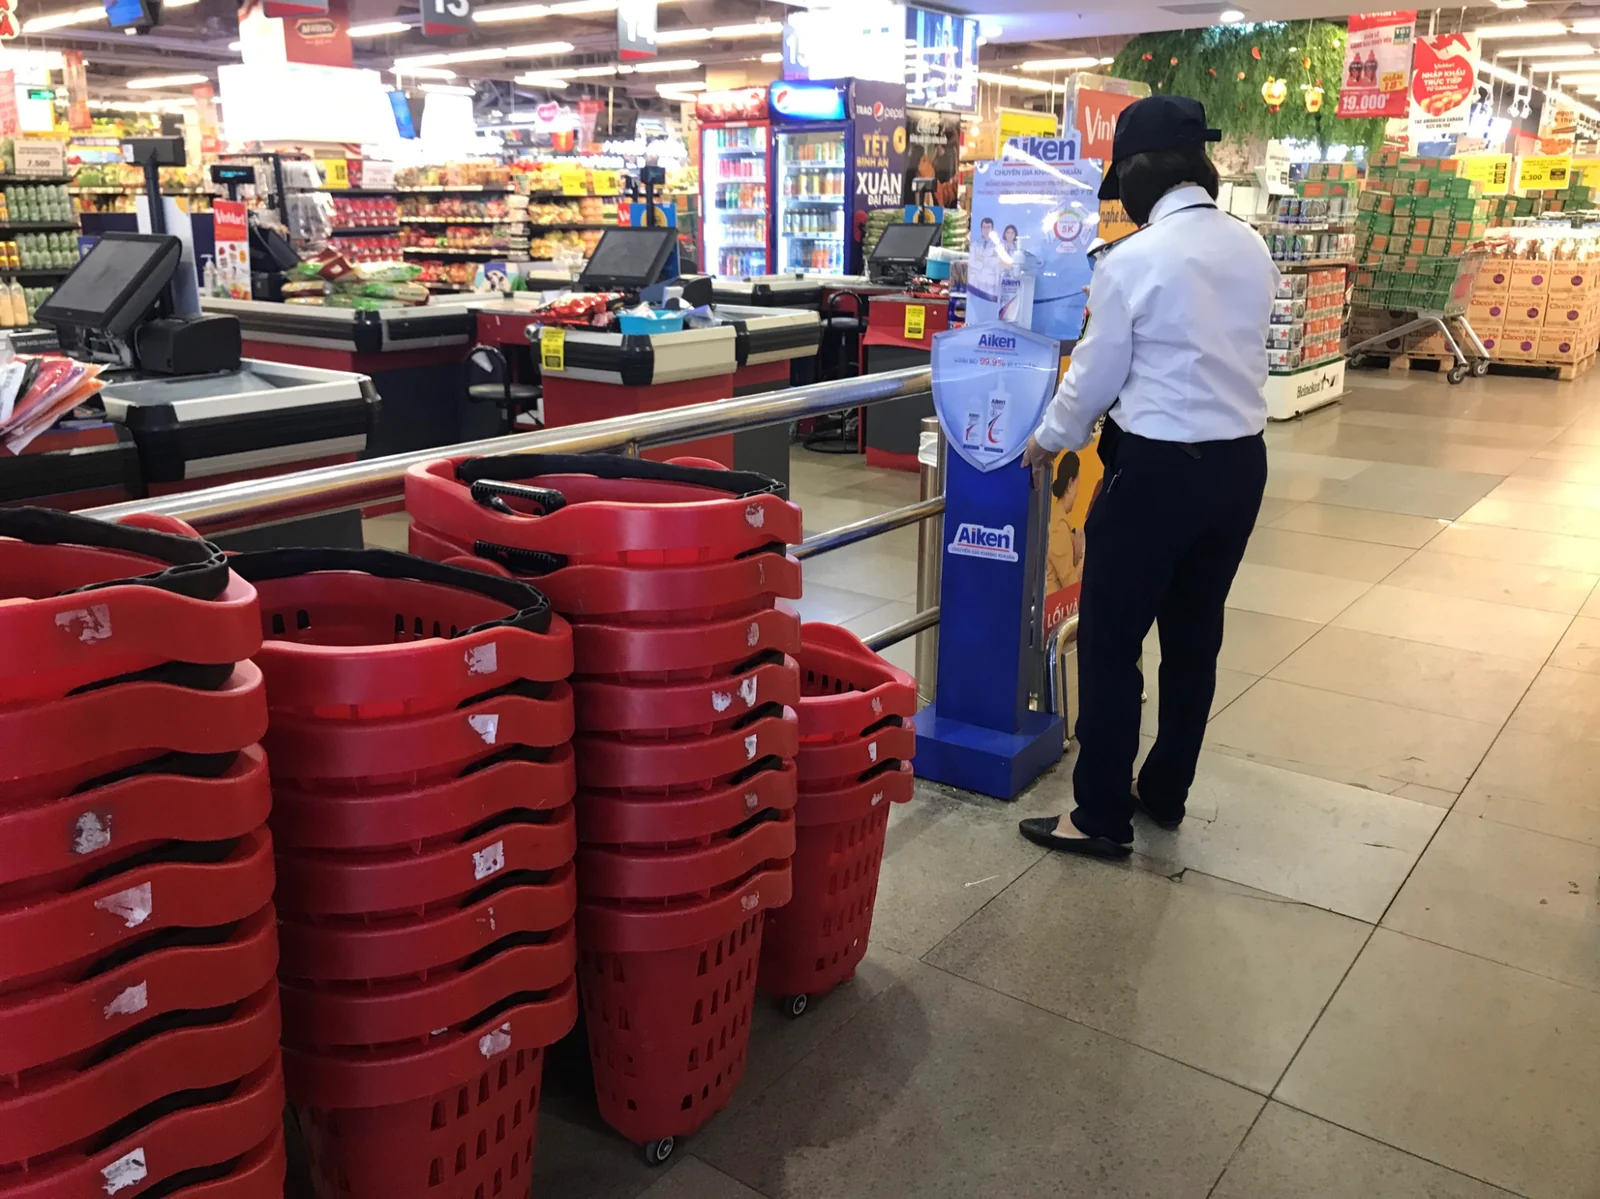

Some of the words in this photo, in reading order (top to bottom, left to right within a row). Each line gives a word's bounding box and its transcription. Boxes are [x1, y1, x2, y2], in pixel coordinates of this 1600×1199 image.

[885, 108, 905, 120] pepsi
[863, 128, 889, 157] TẾT
[856, 167, 902, 195] XUÂN
[1022, 168, 1034, 176] GIA
[978, 333, 1016, 349] Aiken
[980, 356, 1005, 367] 99.9%
[958, 526, 1010, 549] Aiken
[1047, 602, 1064, 629] LỐI
